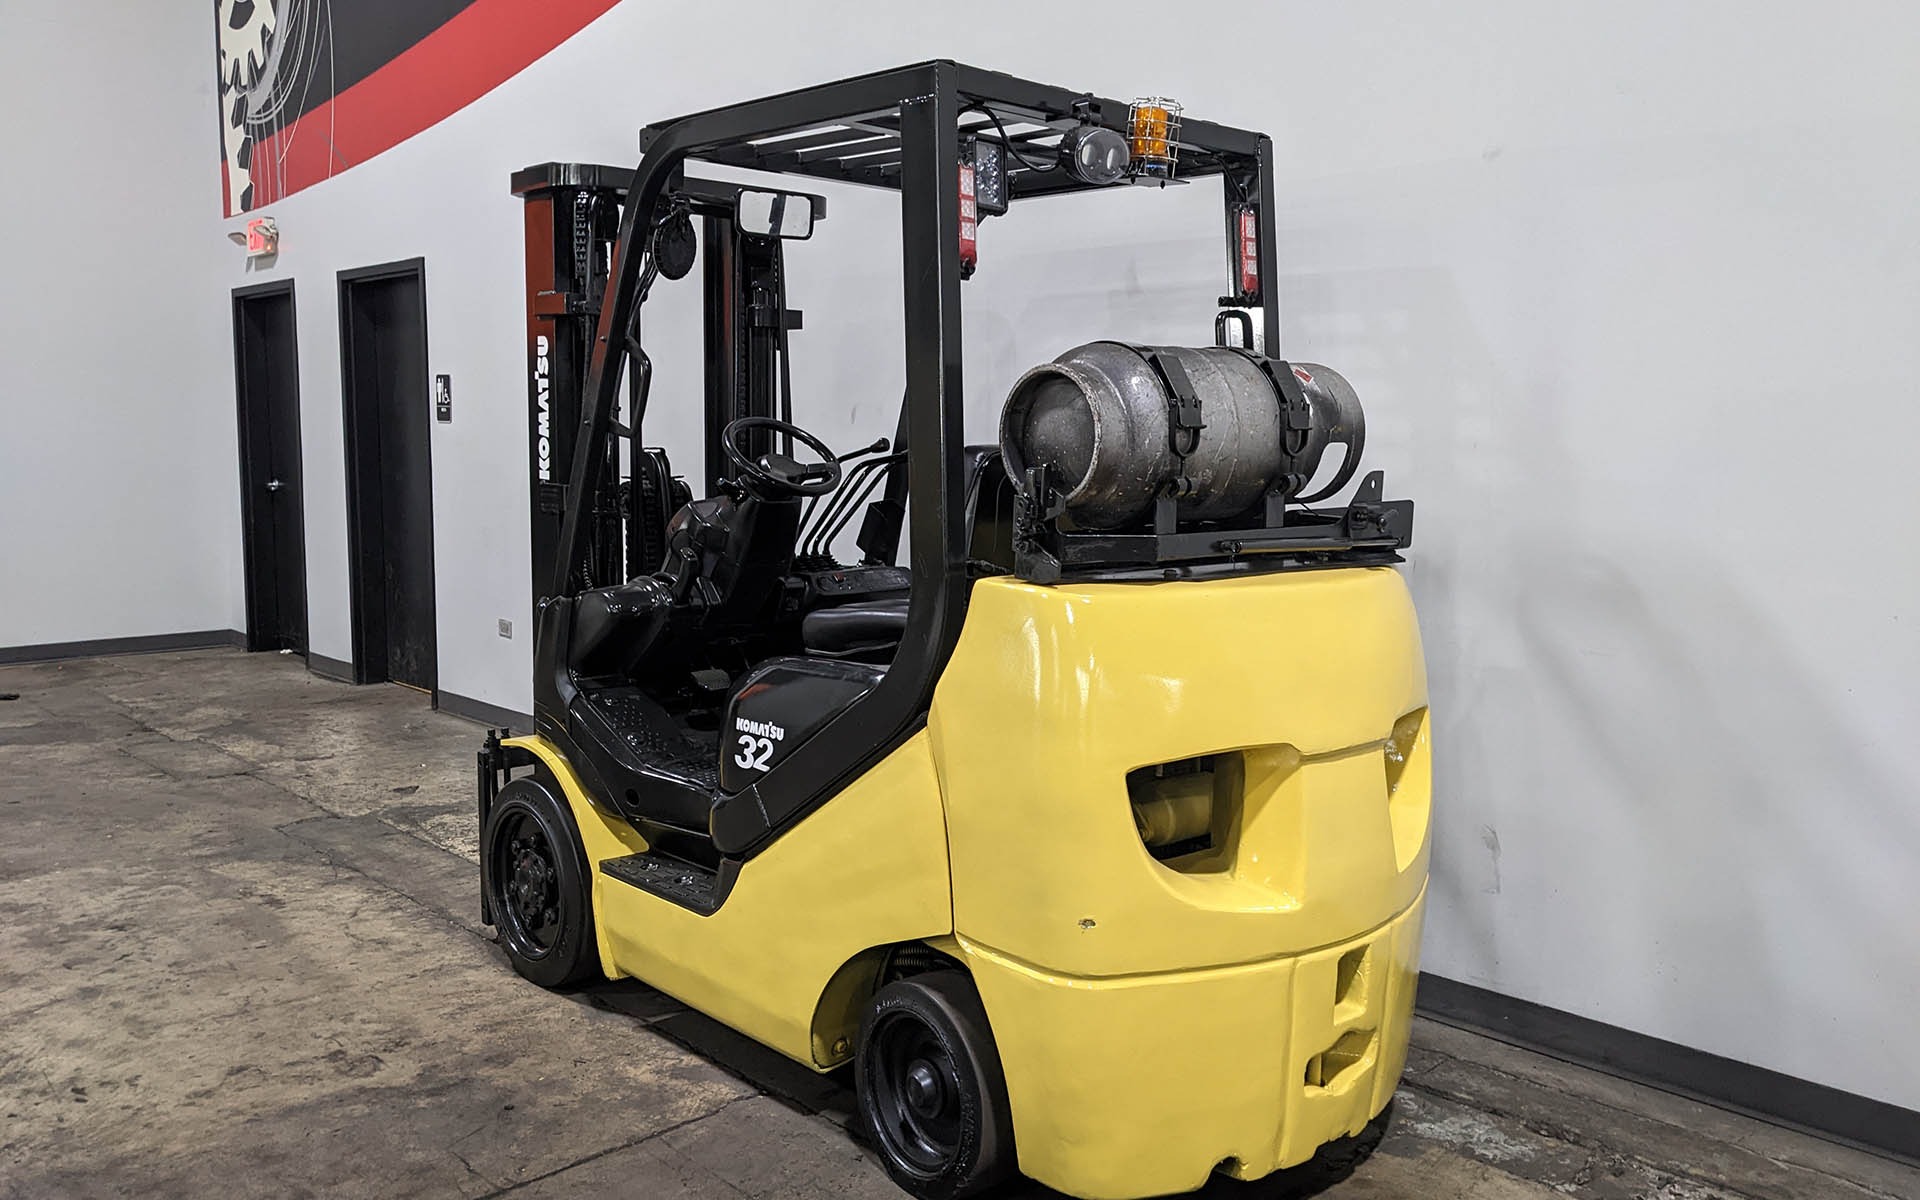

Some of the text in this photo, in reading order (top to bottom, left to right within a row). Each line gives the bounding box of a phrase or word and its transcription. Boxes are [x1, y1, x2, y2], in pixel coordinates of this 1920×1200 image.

[535, 335, 550, 481] KOMATSU
[736, 717, 785, 741] KOMATSU
[734, 734, 774, 772] 32
